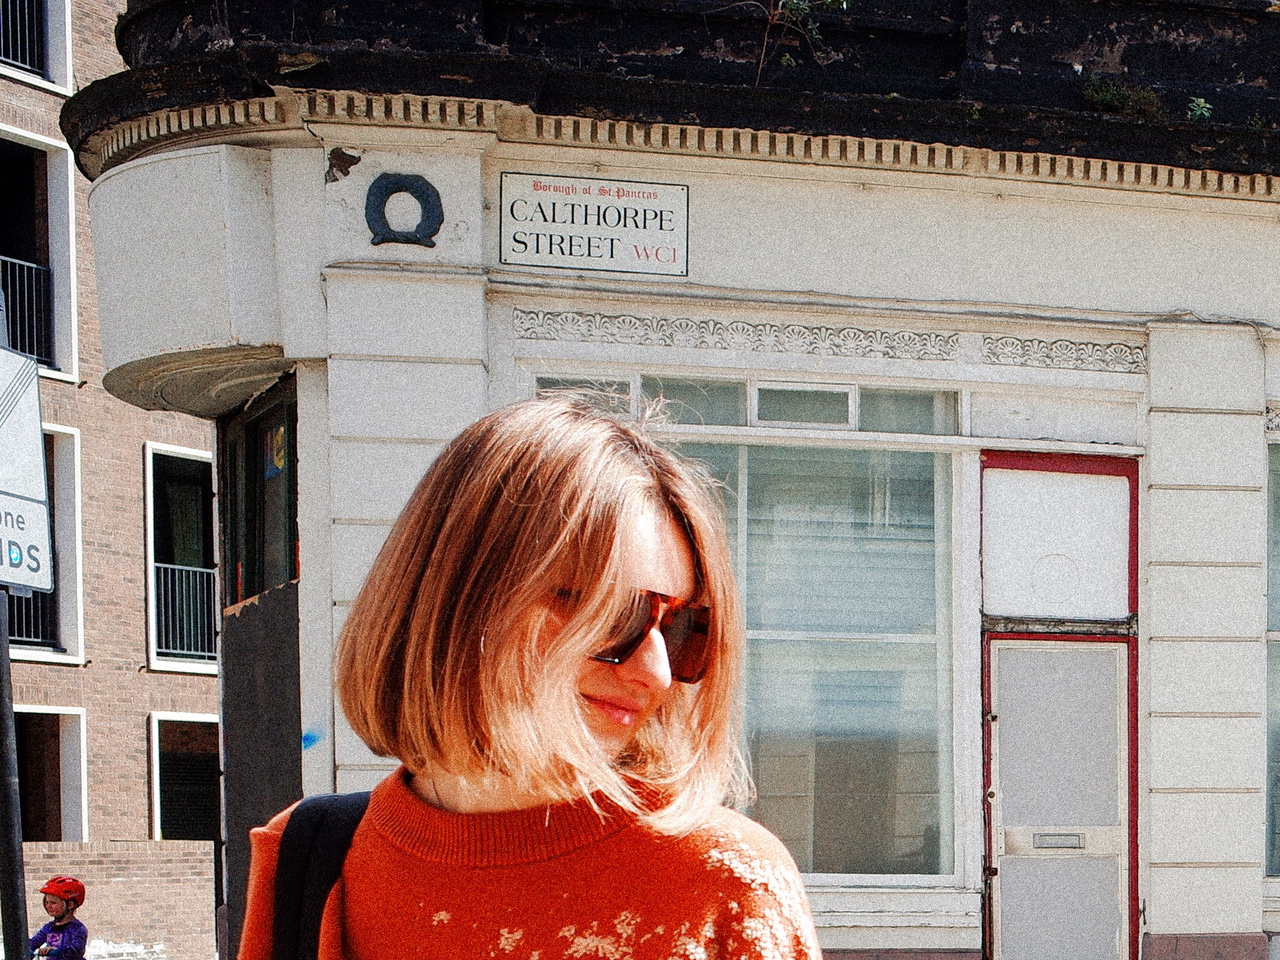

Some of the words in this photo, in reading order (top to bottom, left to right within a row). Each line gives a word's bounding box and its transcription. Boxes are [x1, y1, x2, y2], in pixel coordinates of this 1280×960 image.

[532, 180, 577, 196] Borough
[582, 185, 592, 196] of
[510, 199, 675, 232] CALTHORPE
[512, 231, 622, 259] STREET
[0, 511, 26, 531] ne
